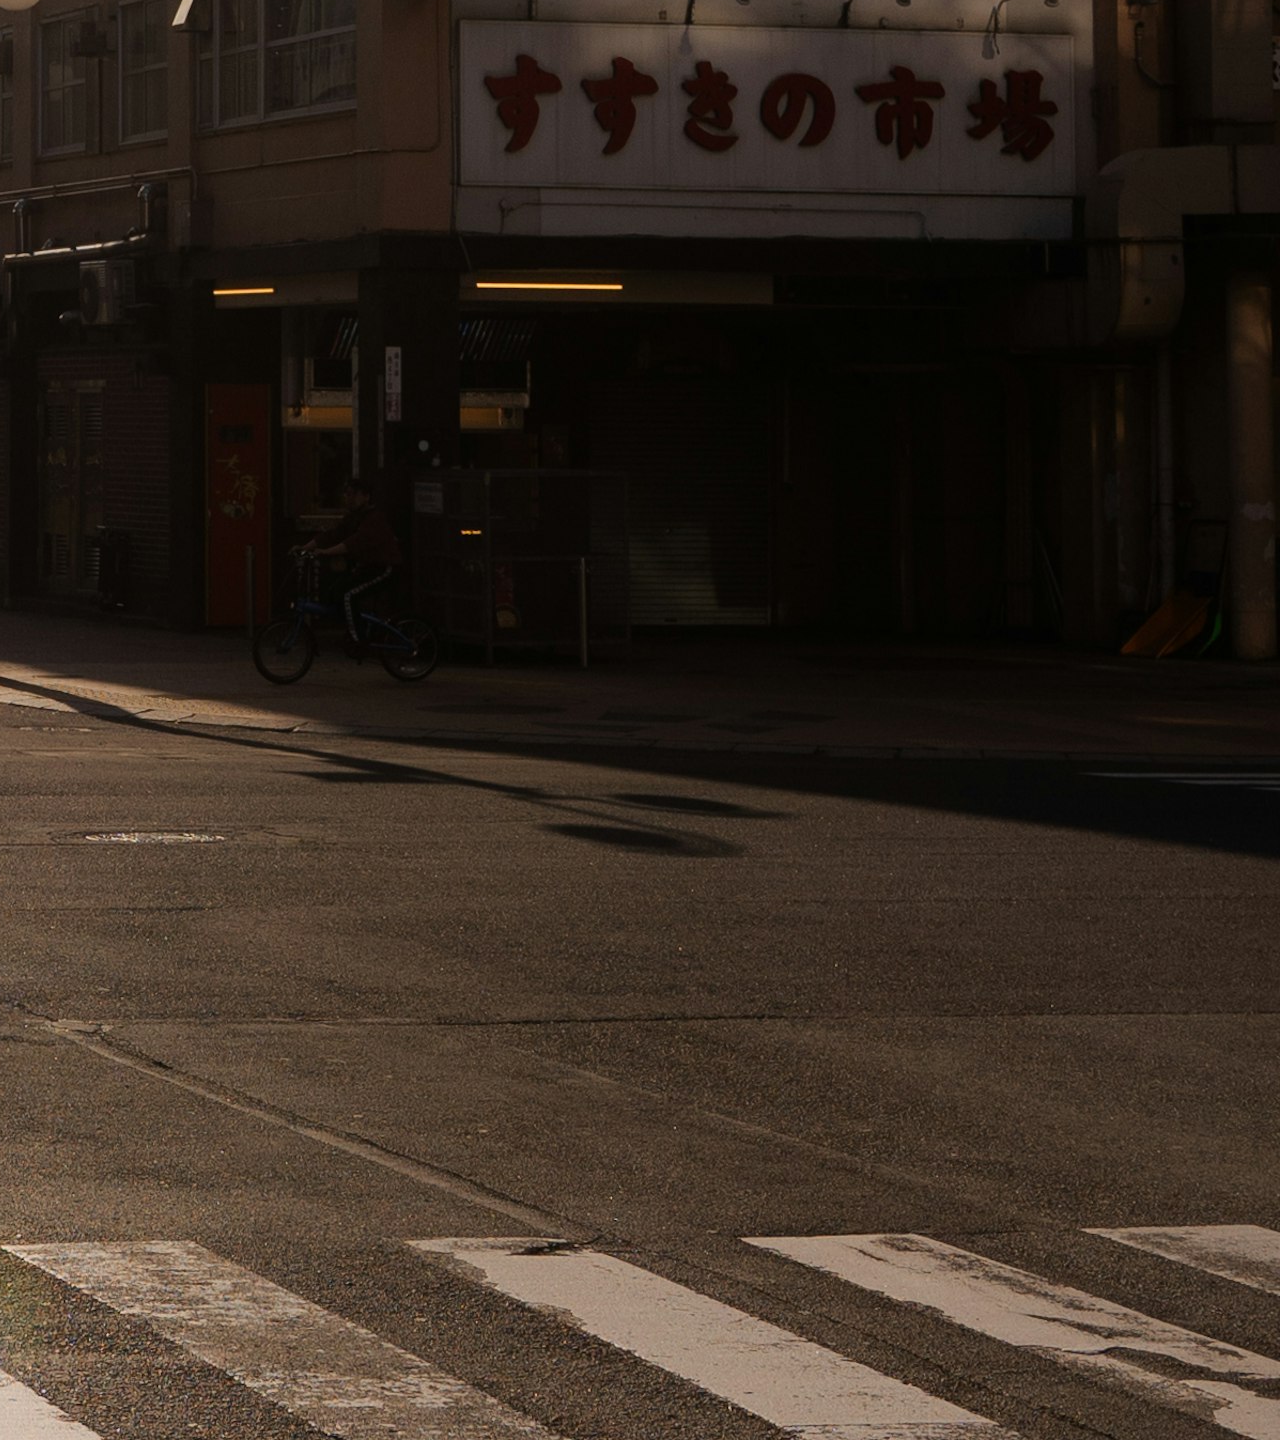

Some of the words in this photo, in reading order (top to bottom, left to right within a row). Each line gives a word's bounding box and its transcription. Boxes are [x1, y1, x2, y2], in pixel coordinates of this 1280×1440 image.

[483, 54, 1059, 162] すすきの市場
